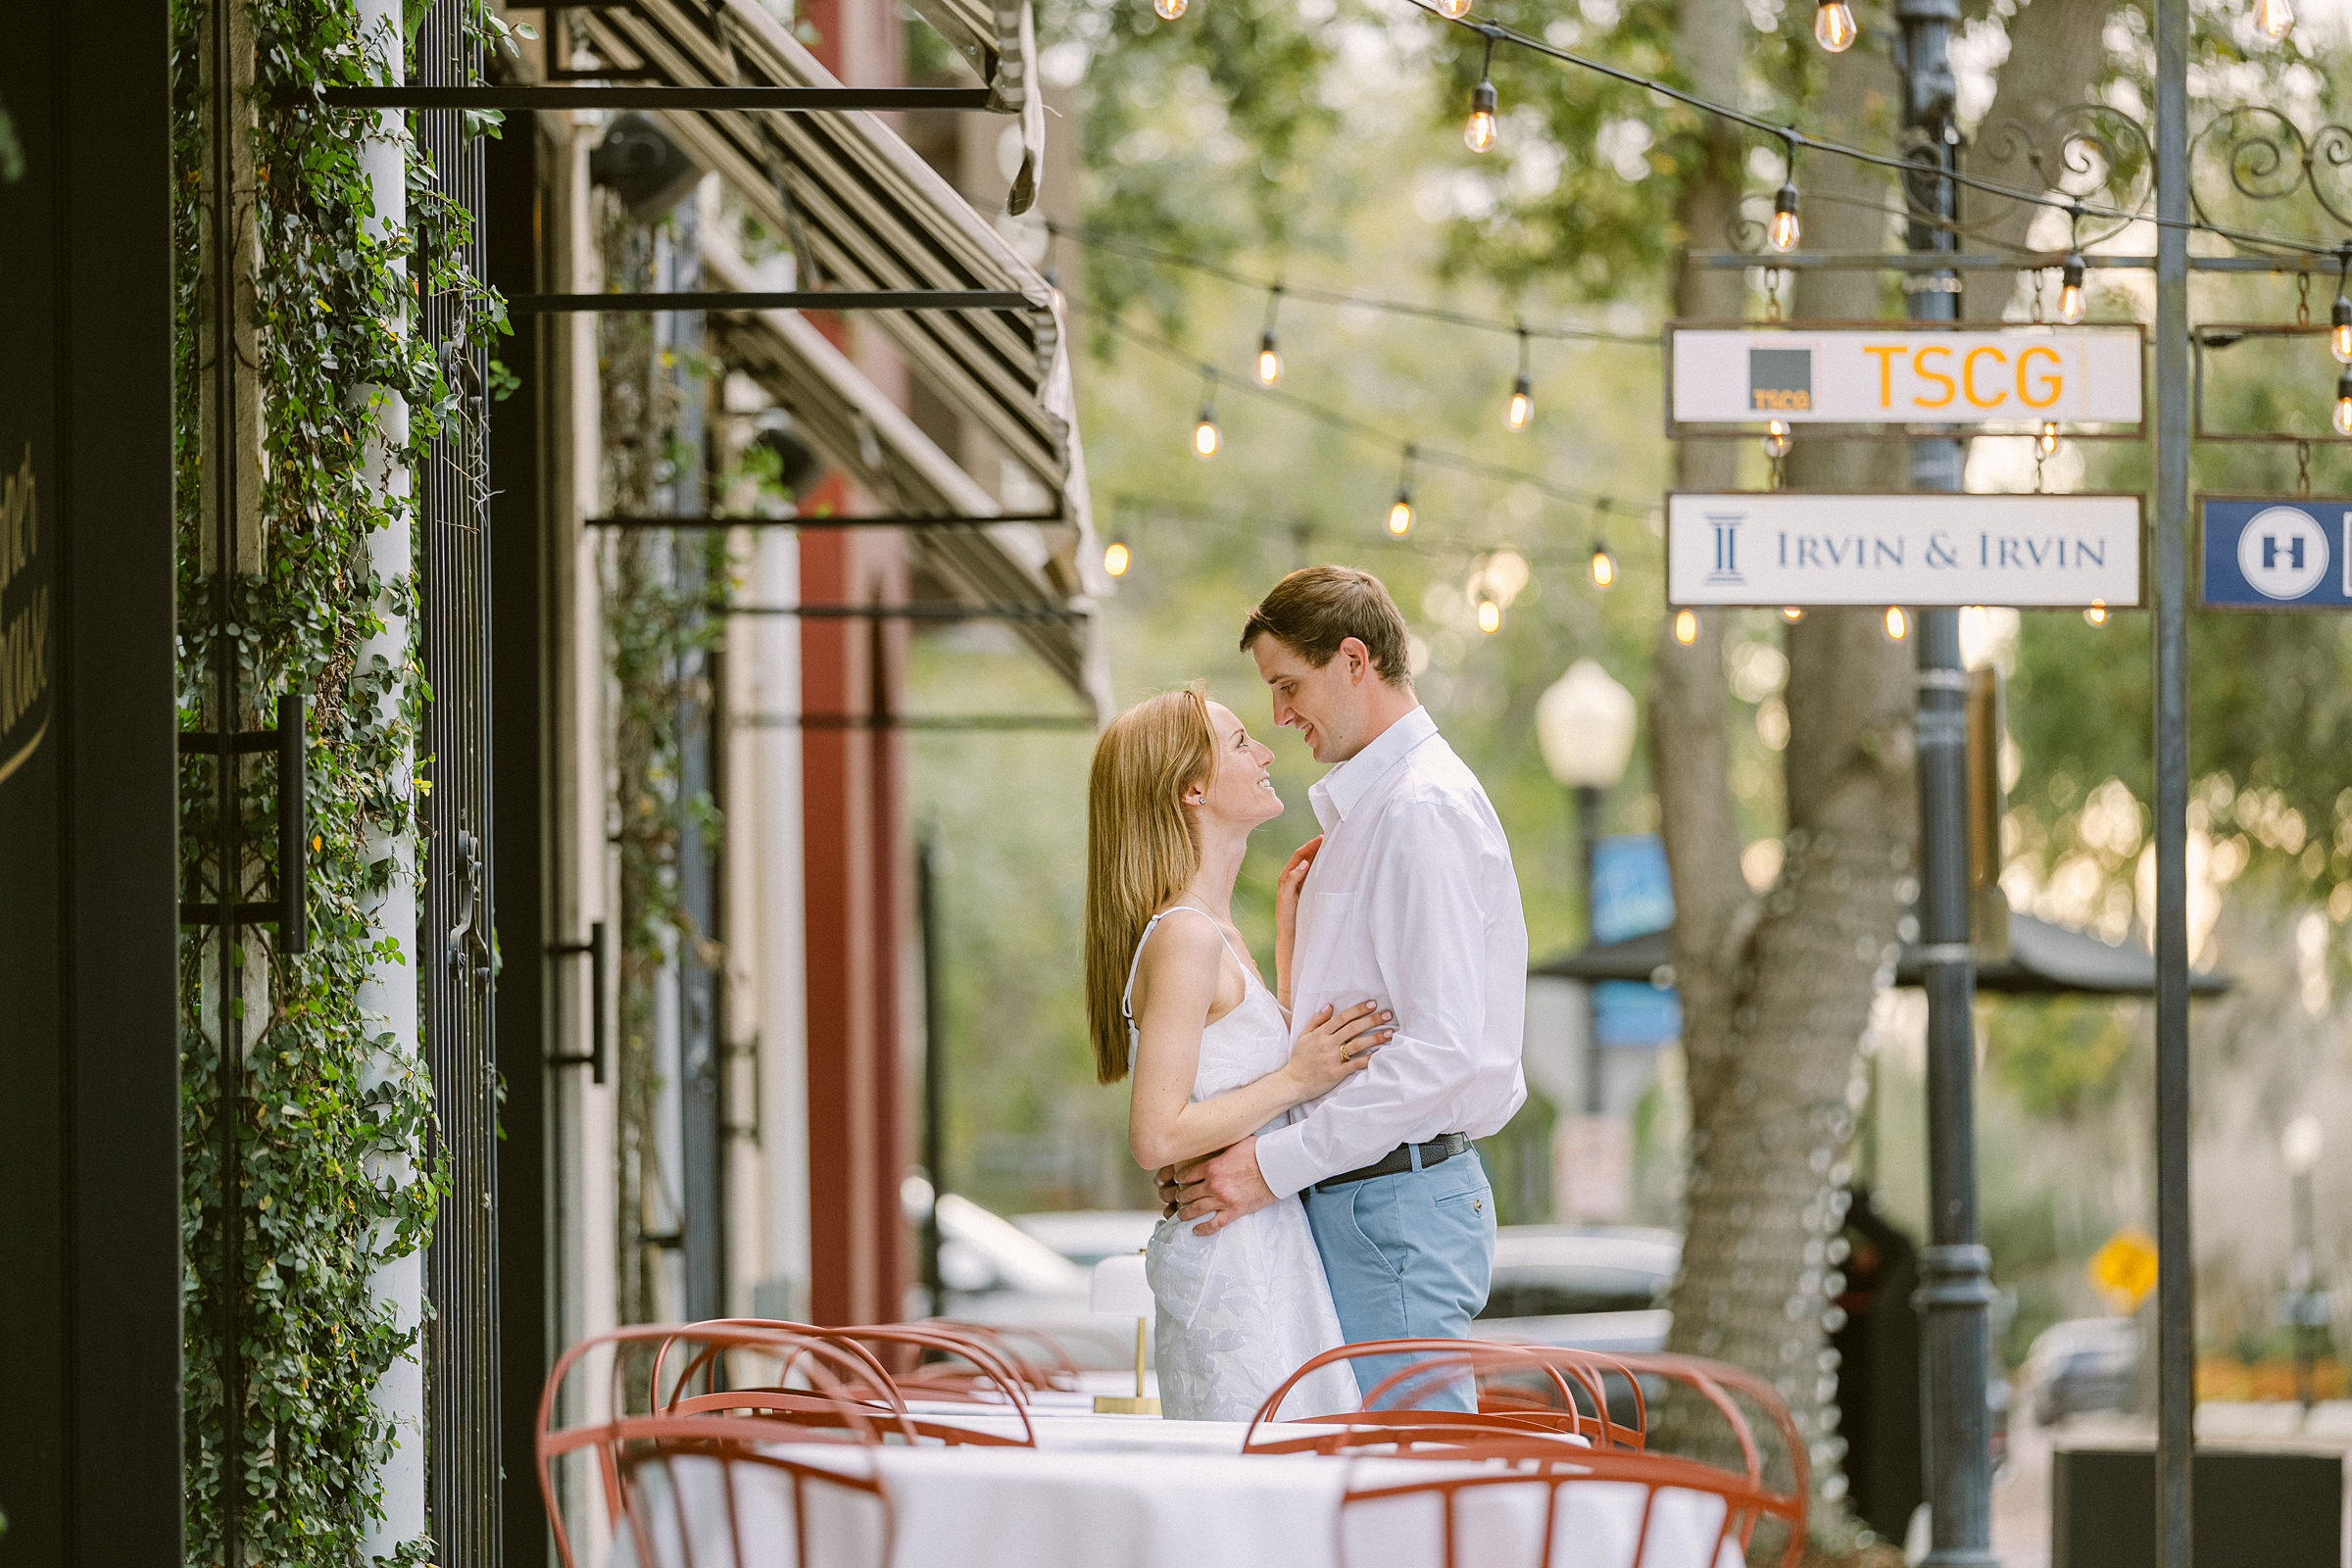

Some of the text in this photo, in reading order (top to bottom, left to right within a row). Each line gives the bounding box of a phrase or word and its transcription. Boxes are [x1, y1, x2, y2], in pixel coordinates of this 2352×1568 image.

[1863, 346, 2063, 408] TSCG
[1778, 529, 2106, 569] IRVIN & IRVIN
[2263, 537, 2304, 568] H
